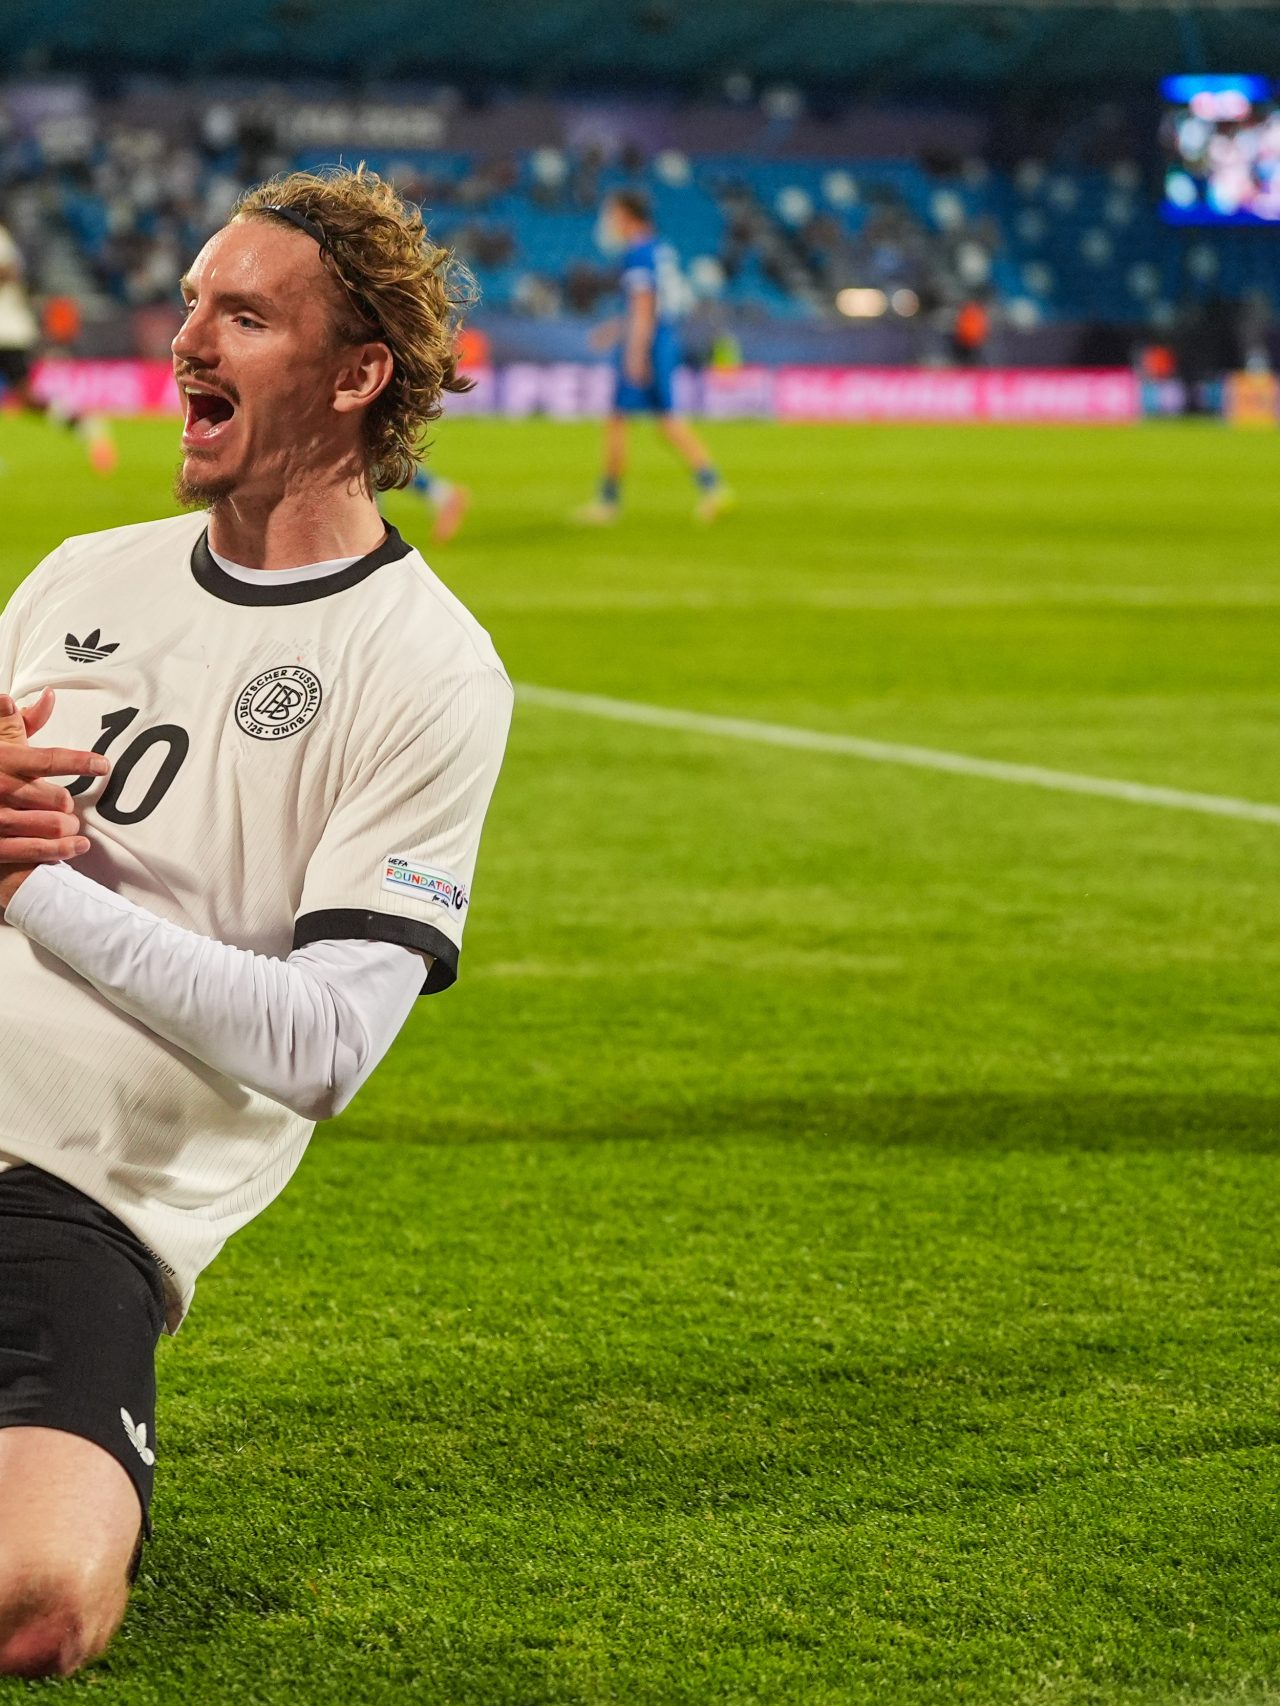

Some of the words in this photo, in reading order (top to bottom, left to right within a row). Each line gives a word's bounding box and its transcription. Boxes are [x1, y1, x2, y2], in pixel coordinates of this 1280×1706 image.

[240, 669, 288, 718] DEUTSCHER
[246, 721, 264, 735] 125
[64, 706, 190, 826] 10
[388, 858, 408, 867] UEFA
